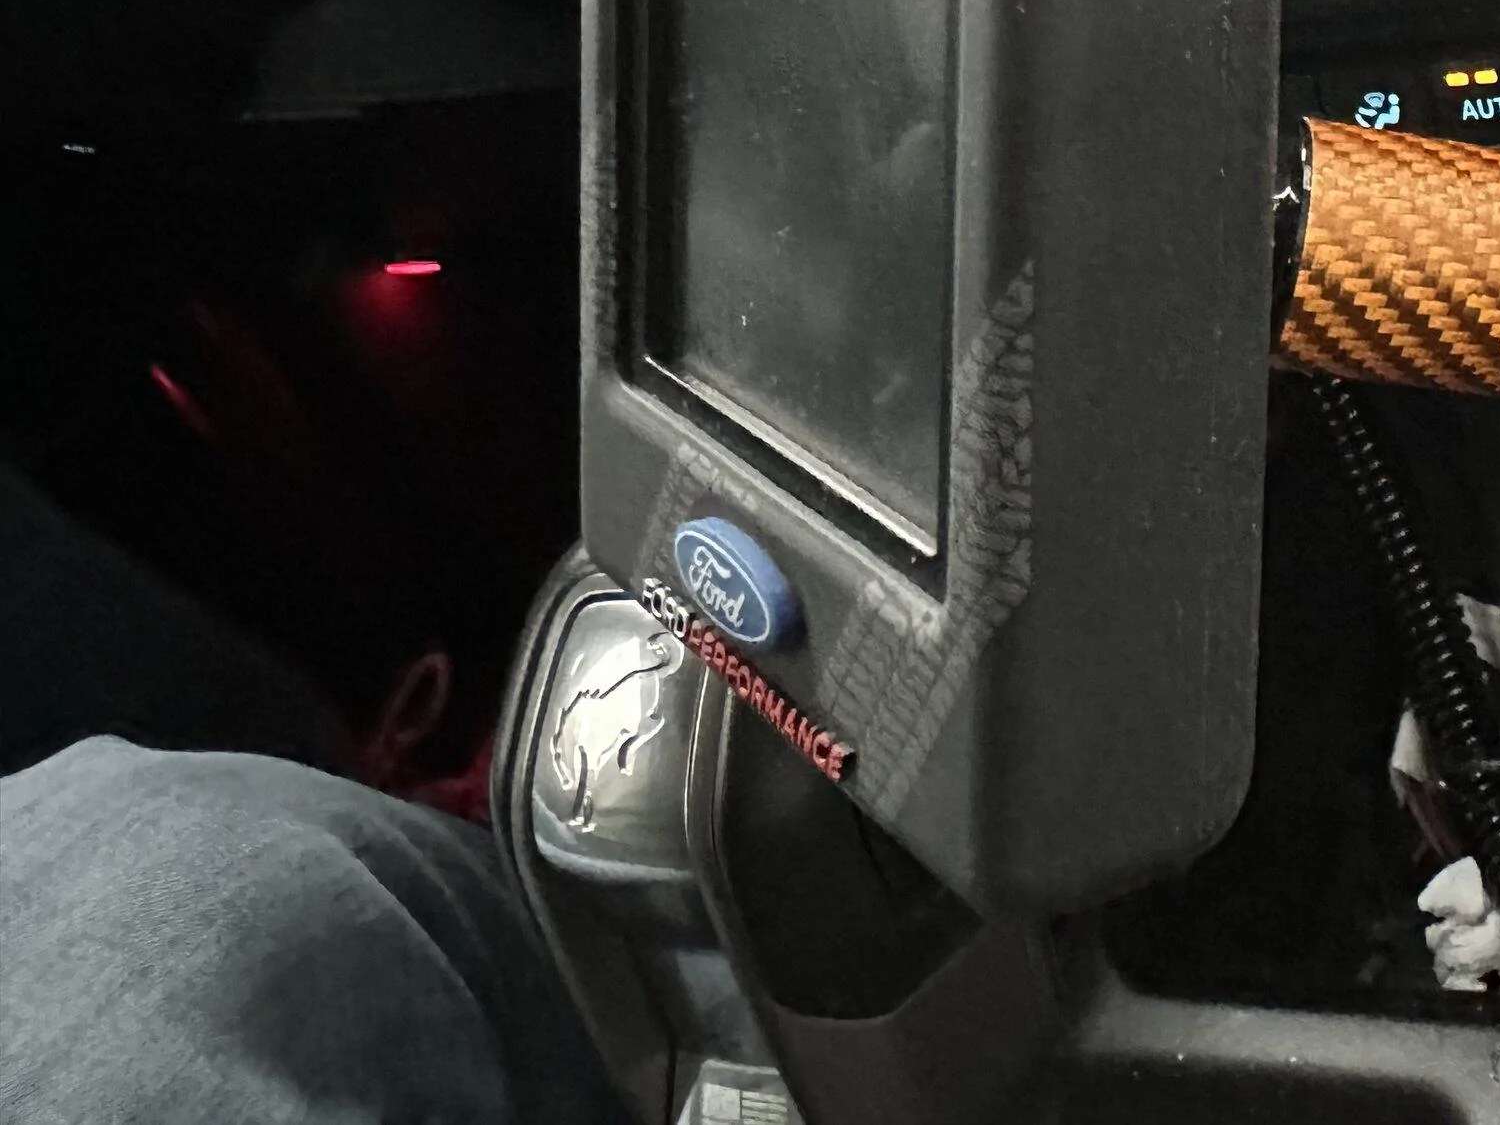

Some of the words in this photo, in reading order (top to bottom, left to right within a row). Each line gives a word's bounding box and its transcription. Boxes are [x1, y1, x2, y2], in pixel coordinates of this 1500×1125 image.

[688, 545, 746, 628] Ford
[642, 577, 690, 638] FORD
[687, 618, 854, 783] PERFORMANCE
